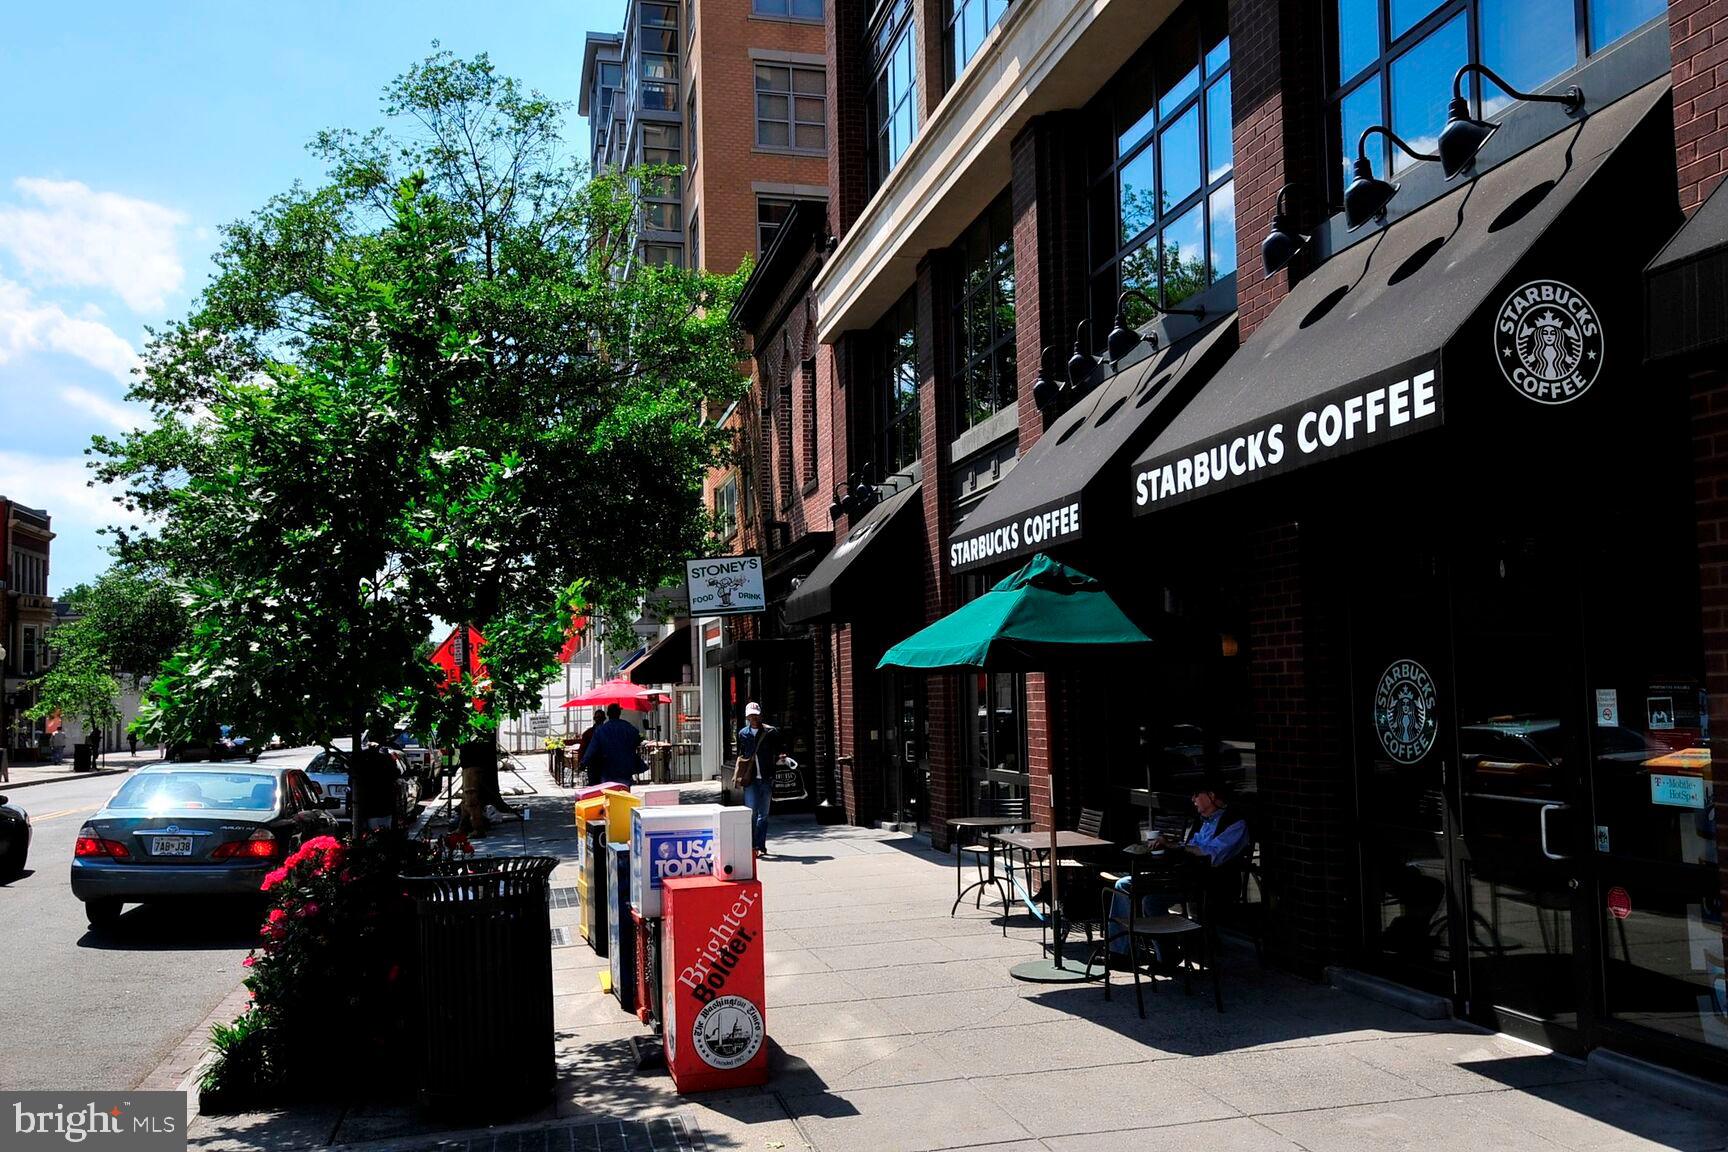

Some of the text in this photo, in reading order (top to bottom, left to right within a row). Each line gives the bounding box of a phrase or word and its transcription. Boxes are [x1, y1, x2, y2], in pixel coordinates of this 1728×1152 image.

[1500, 286, 1597, 337] STARBUCKS
[1513, 368, 1586, 399] COFFEE
[1136, 369, 1436, 505] STARBUCKS COFFEE
[950, 502, 1079, 567] STARBUCKS COFFEE
[692, 559, 758, 579] STONEY'S
[693, 592, 761, 605] FOOD DRINK
[1378, 664, 1435, 709] STARBUCKS
[1384, 732, 1428, 759] COFFEE
[677, 840, 714, 858] USA
[677, 889, 759, 990] Brighter.
[691, 926, 757, 1004] Bolder.
